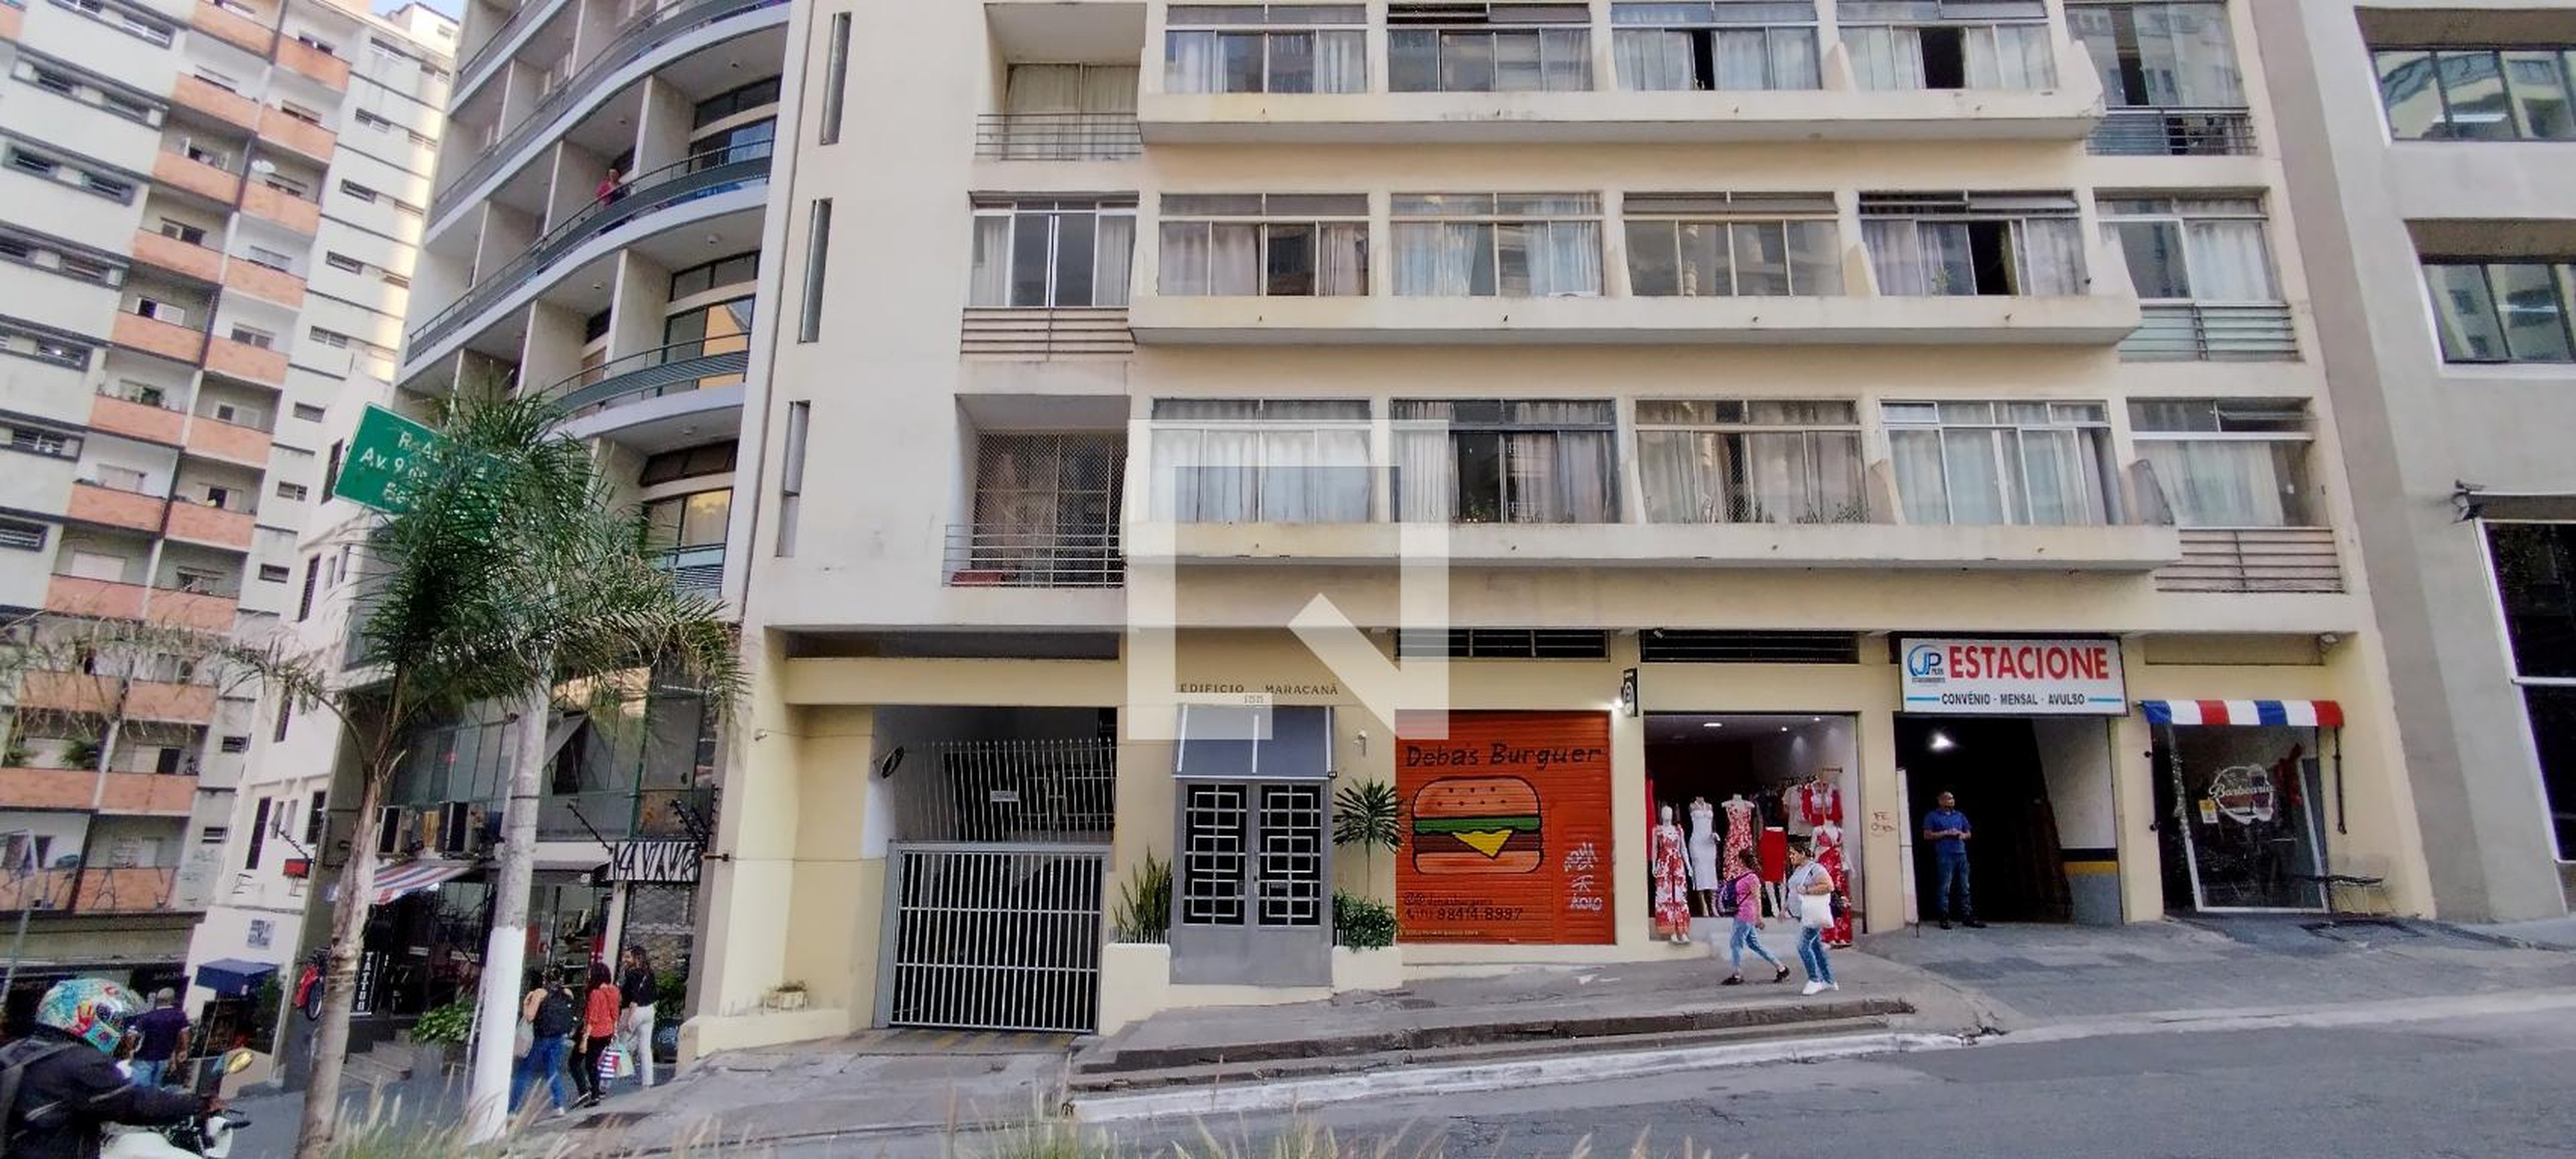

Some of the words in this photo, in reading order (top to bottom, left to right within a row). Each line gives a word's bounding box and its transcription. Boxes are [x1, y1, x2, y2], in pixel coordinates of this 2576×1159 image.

[359, 447, 388, 469] Av.
[394, 457, 404, 474] 9
[1948, 646, 2108, 679] ESTACIONE
[1180, 684, 1244, 694] EDIFICIO
[1265, 683, 1338, 696] MARACANÃ
[2000, 693, 2037, 705] MENSAL
[2049, 694, 2084, 705] AVULSO
[1490, 742, 1601, 769] Burguer
[357, 951, 374, 1011] TATTOO
